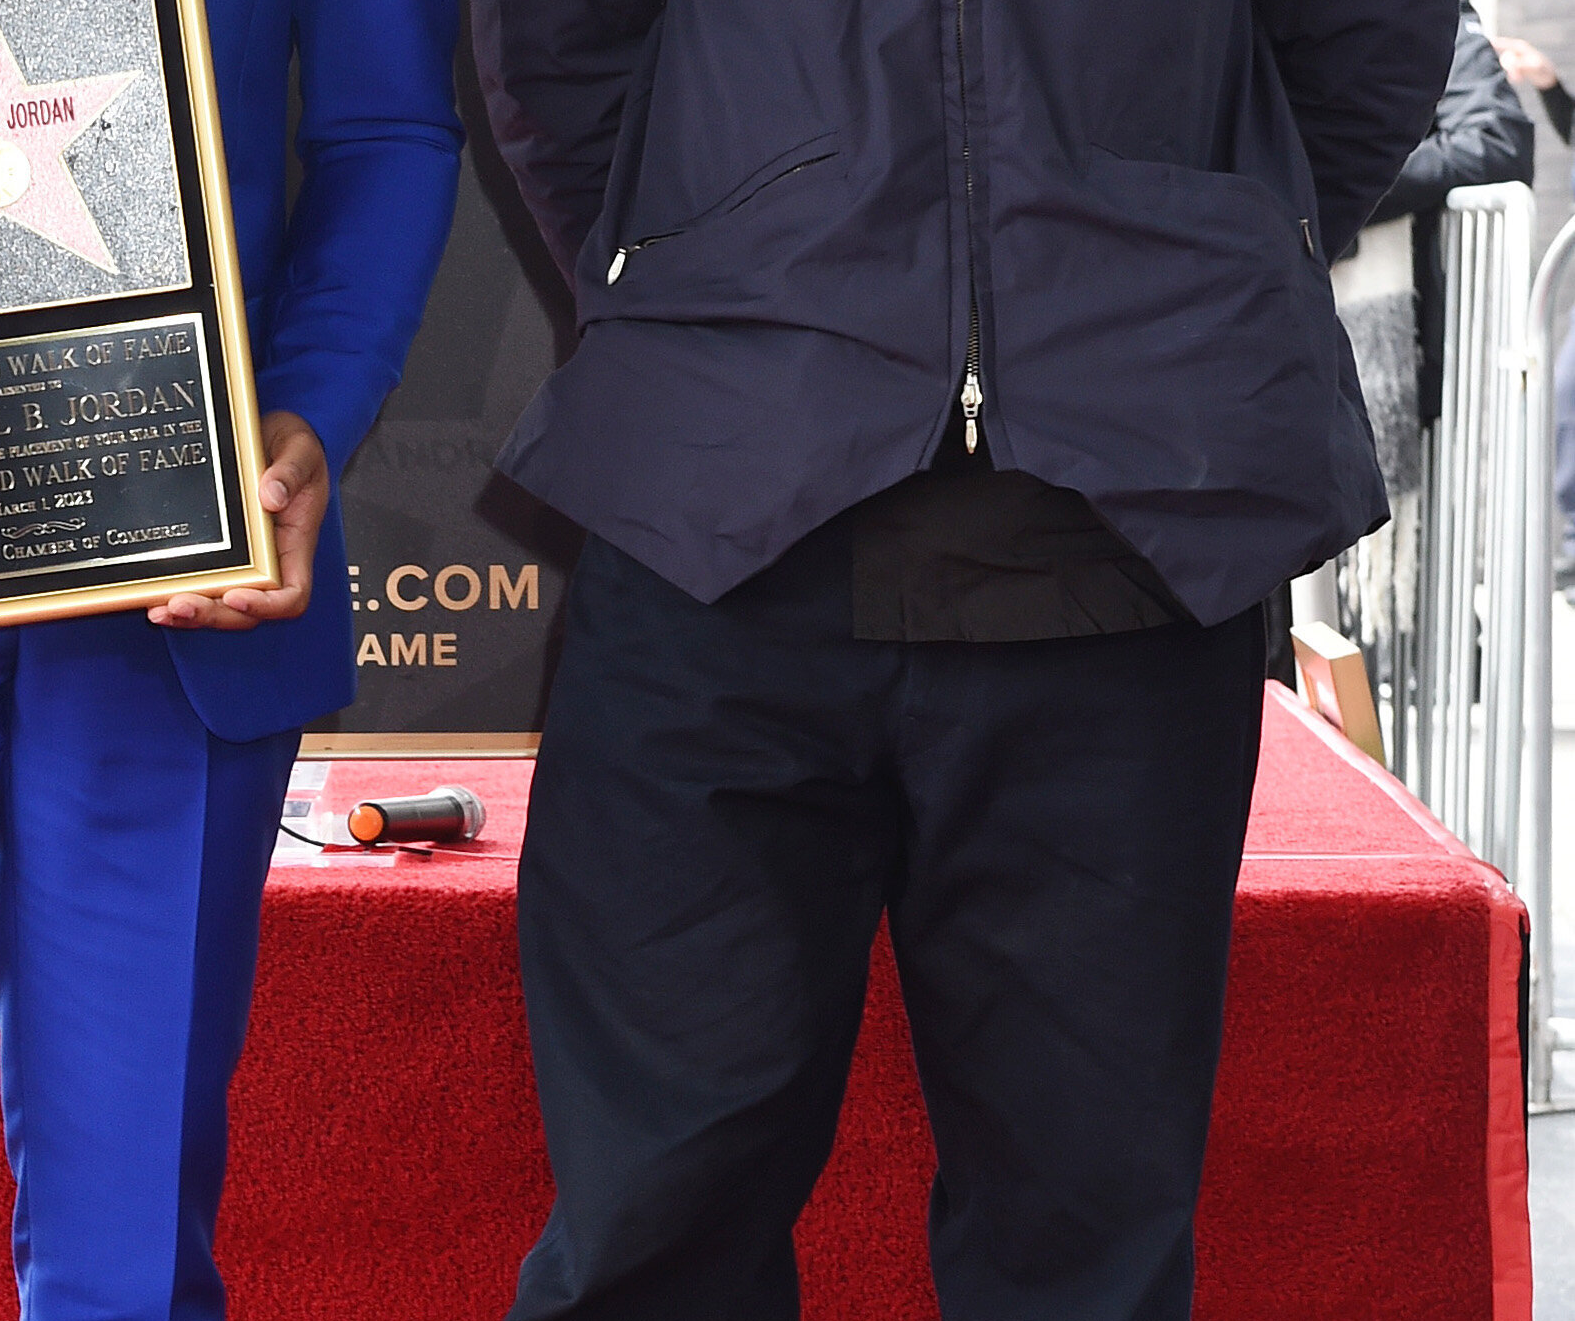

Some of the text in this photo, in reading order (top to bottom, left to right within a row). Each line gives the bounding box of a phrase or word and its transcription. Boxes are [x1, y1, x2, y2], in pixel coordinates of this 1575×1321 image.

[7, 96, 76, 130] JORDAN
[7, 347, 79, 376] WALK
[85, 342, 115, 366] OF
[123, 331, 192, 361] FAME
[22, 402, 50, 432] B.
[60, 380, 196, 427] JORDAN
[8, 438, 73, 459] PLACEMENT
[75, 434, 91, 449] OF
[94, 430, 127, 446] YOUR
[128, 426, 160, 442] STAR
[162, 423, 177, 438] IN
[179, 419, 203, 433] THE
[23, 457, 96, 488] WALK
[101, 452, 130, 477] OF
[138, 442, 207, 472] FAME
[53, 488, 95, 509] 2023
